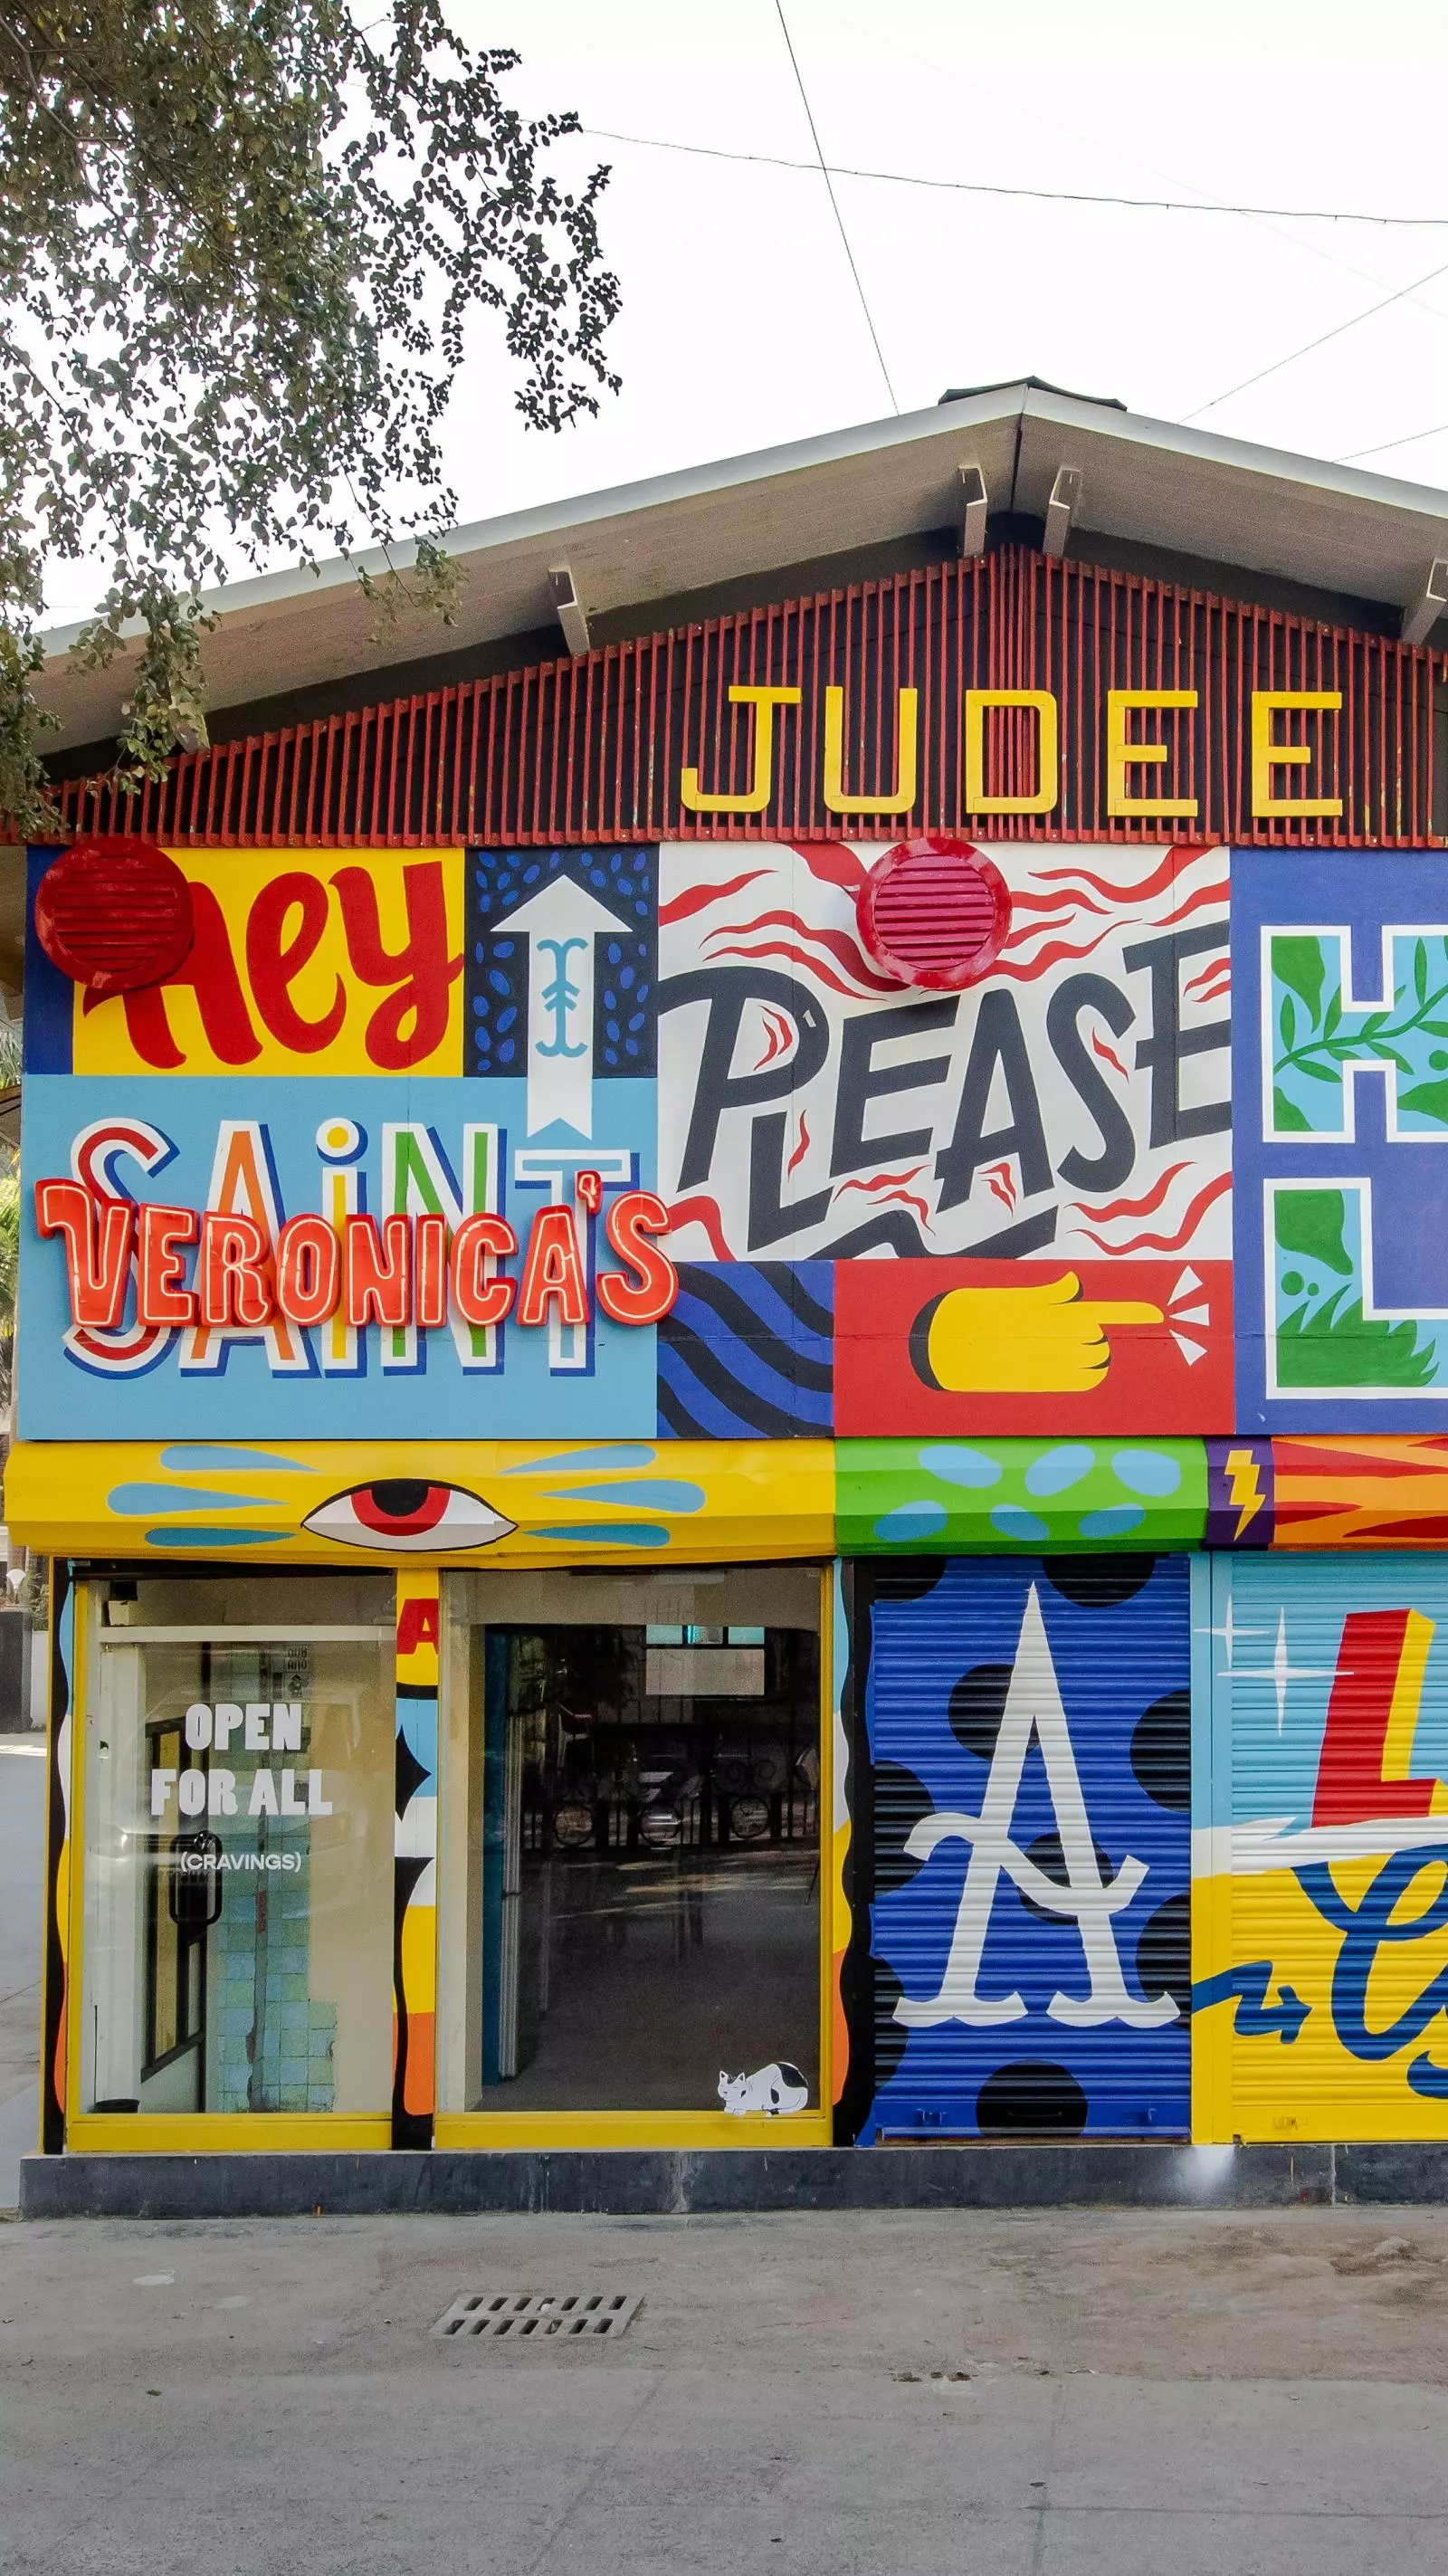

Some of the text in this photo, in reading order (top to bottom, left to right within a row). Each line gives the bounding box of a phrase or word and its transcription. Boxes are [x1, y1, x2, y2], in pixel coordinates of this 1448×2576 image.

[681, 685, 1343, 817] JUDEE
[658, 920, 1233, 1251] PLEASE
[34, 1170, 678, 1328] VERONICA'S
[150, 1768, 333, 1816] FOR ALL
[185, 1703, 302, 1751] OPEN
[180, 1851, 302, 1873] (CRAVINGS)
[892, 1580, 1181, 2028] A
